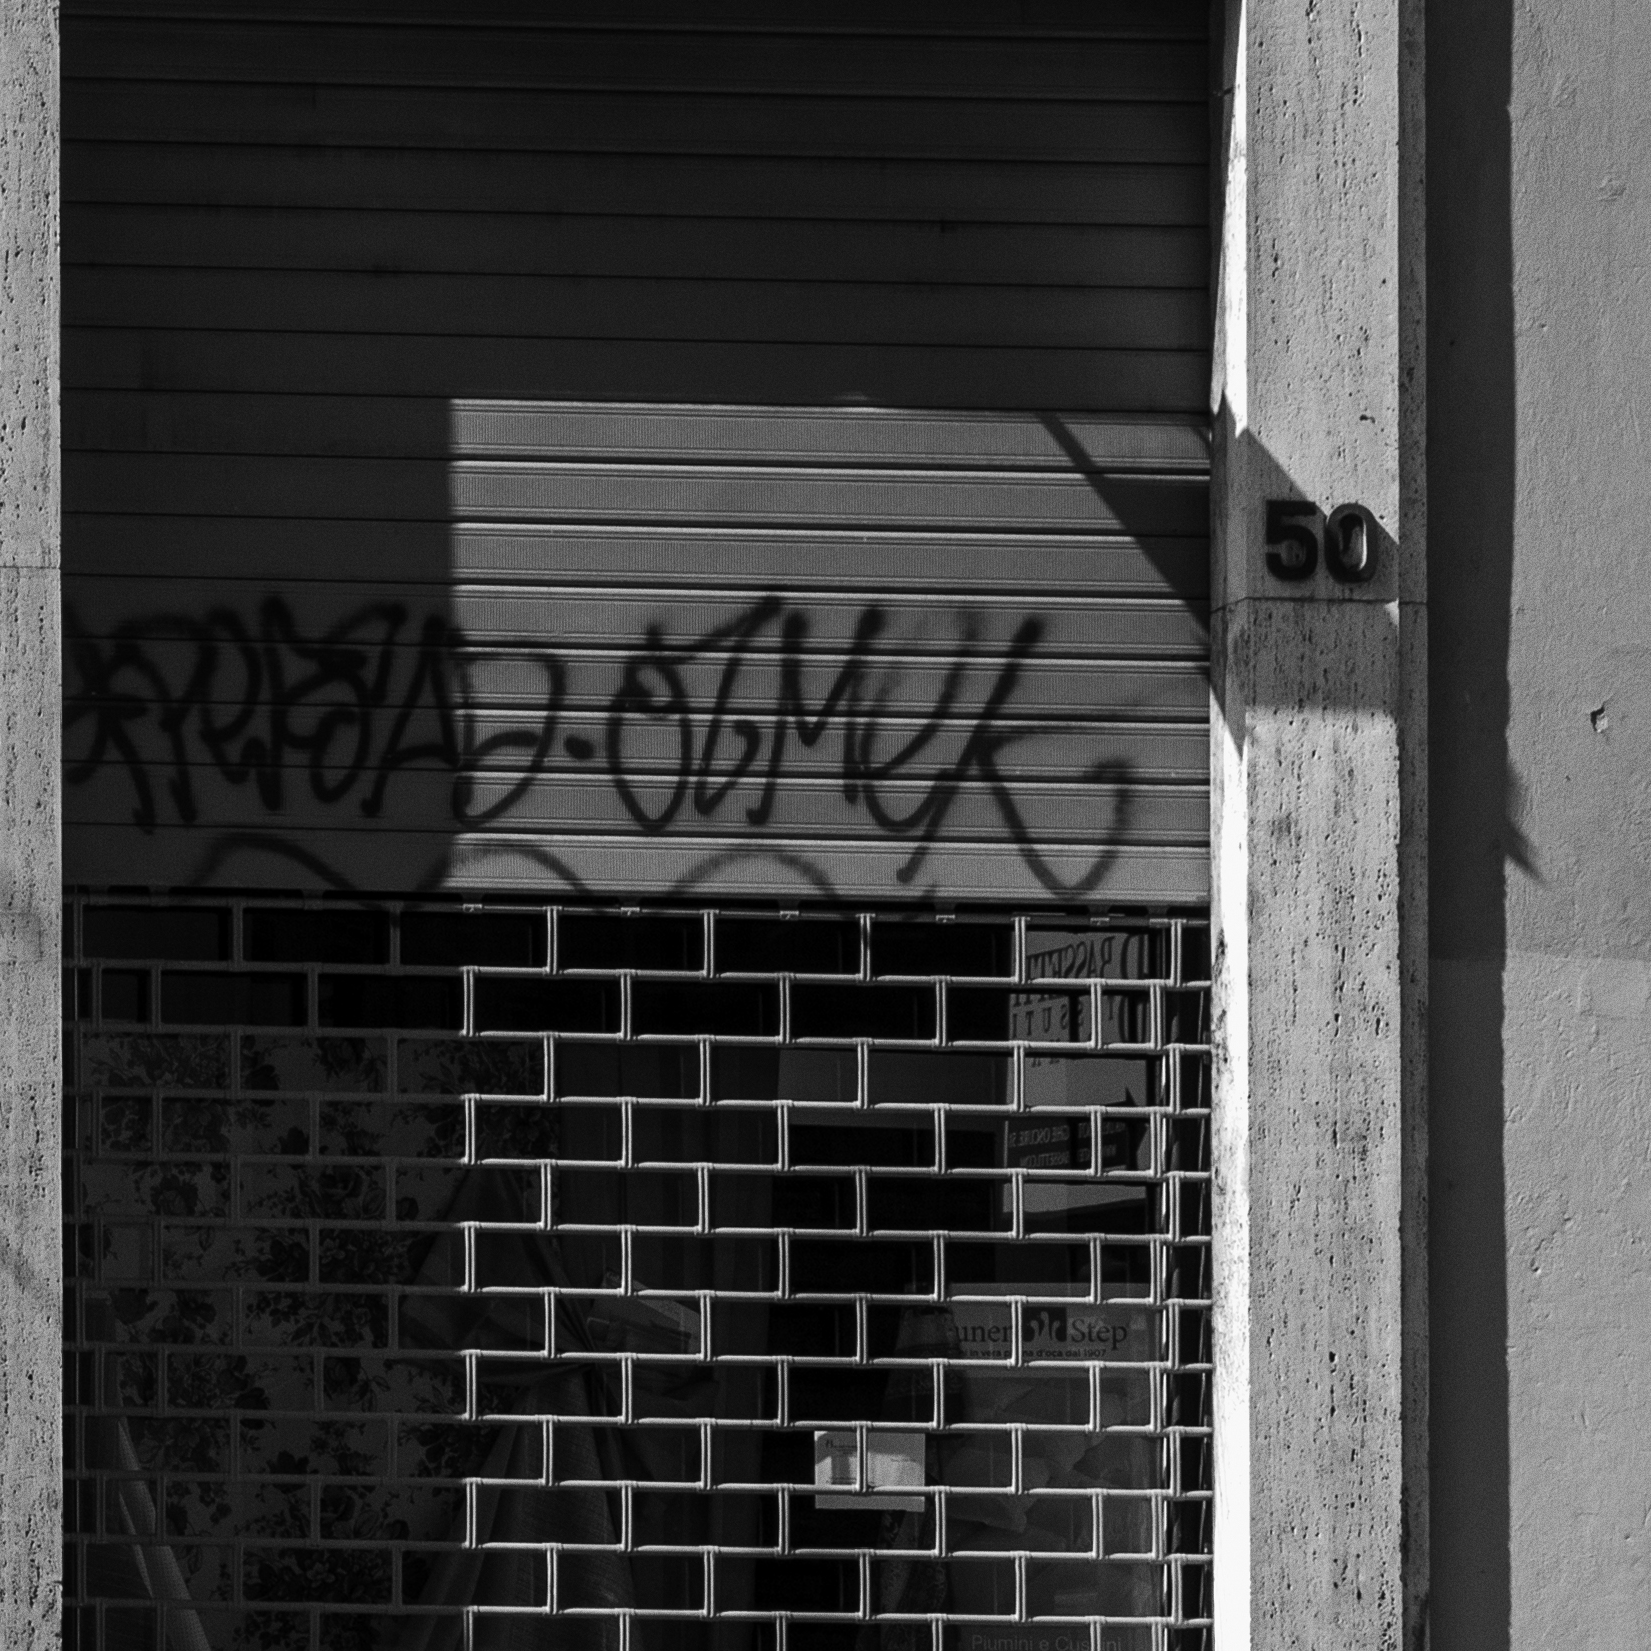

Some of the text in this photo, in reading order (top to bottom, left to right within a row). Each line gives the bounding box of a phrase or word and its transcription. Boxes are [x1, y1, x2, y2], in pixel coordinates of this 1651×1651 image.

[1265, 499, 1379, 583] 50
[1071, 1318, 1128, 1351] Step
[971, 1634, 1033, 1651] Piumini
[1038, 1639, 1049, 1651] e
